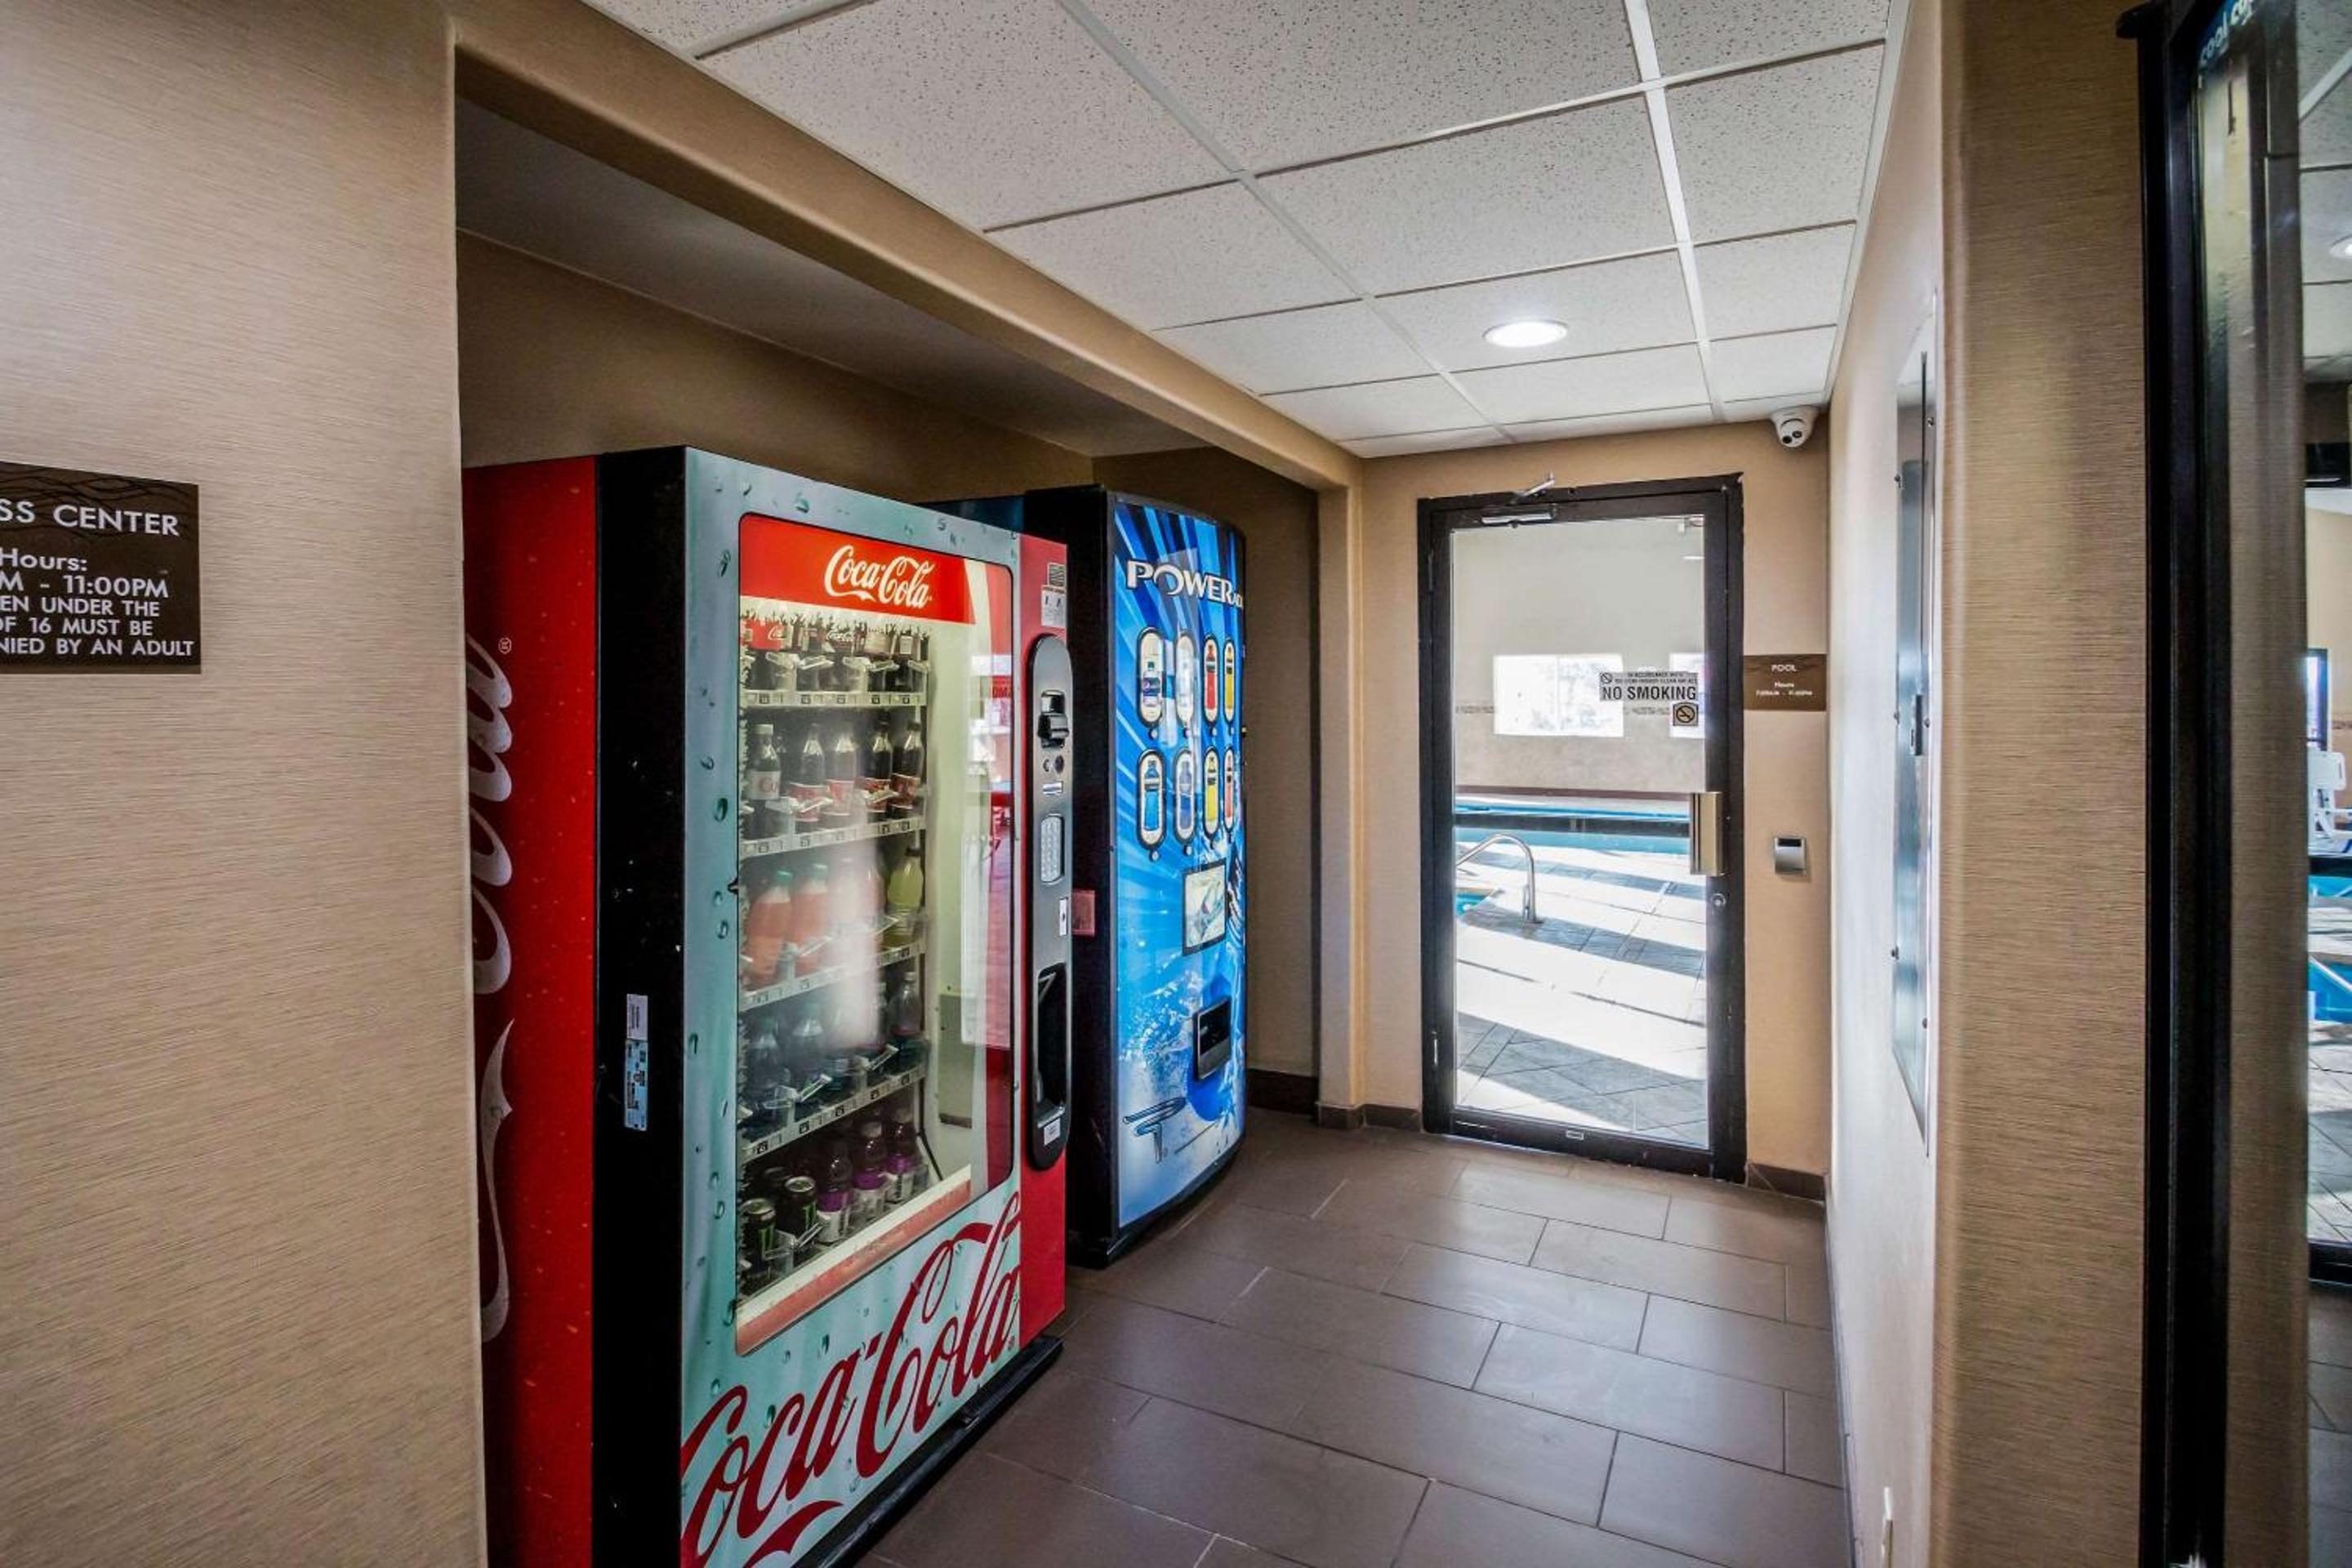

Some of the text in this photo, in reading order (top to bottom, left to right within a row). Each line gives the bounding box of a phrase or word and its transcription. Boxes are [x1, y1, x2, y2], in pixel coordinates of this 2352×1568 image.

[53, 504, 180, 537] CENTER
[0, 547, 87, 572] Hours:
[64, 574, 169, 599] 11:00PM
[824, 545, 936, 609] Coca-Cola
[1127, 560, 1243, 608] POWERAD
[42, 596, 114, 616] UNDER
[122, 599, 160, 617] THE
[29, 617, 51, 635] 16
[62, 618, 121, 635] MUST
[130, 621, 154, 636] BE
[56, 639, 82, 655] BY
[91, 639, 122, 655] AN
[131, 639, 195, 657] ADULT
[1771, 664, 1797, 672] POOL
[1602, 686, 1696, 700] NO SMOKING
